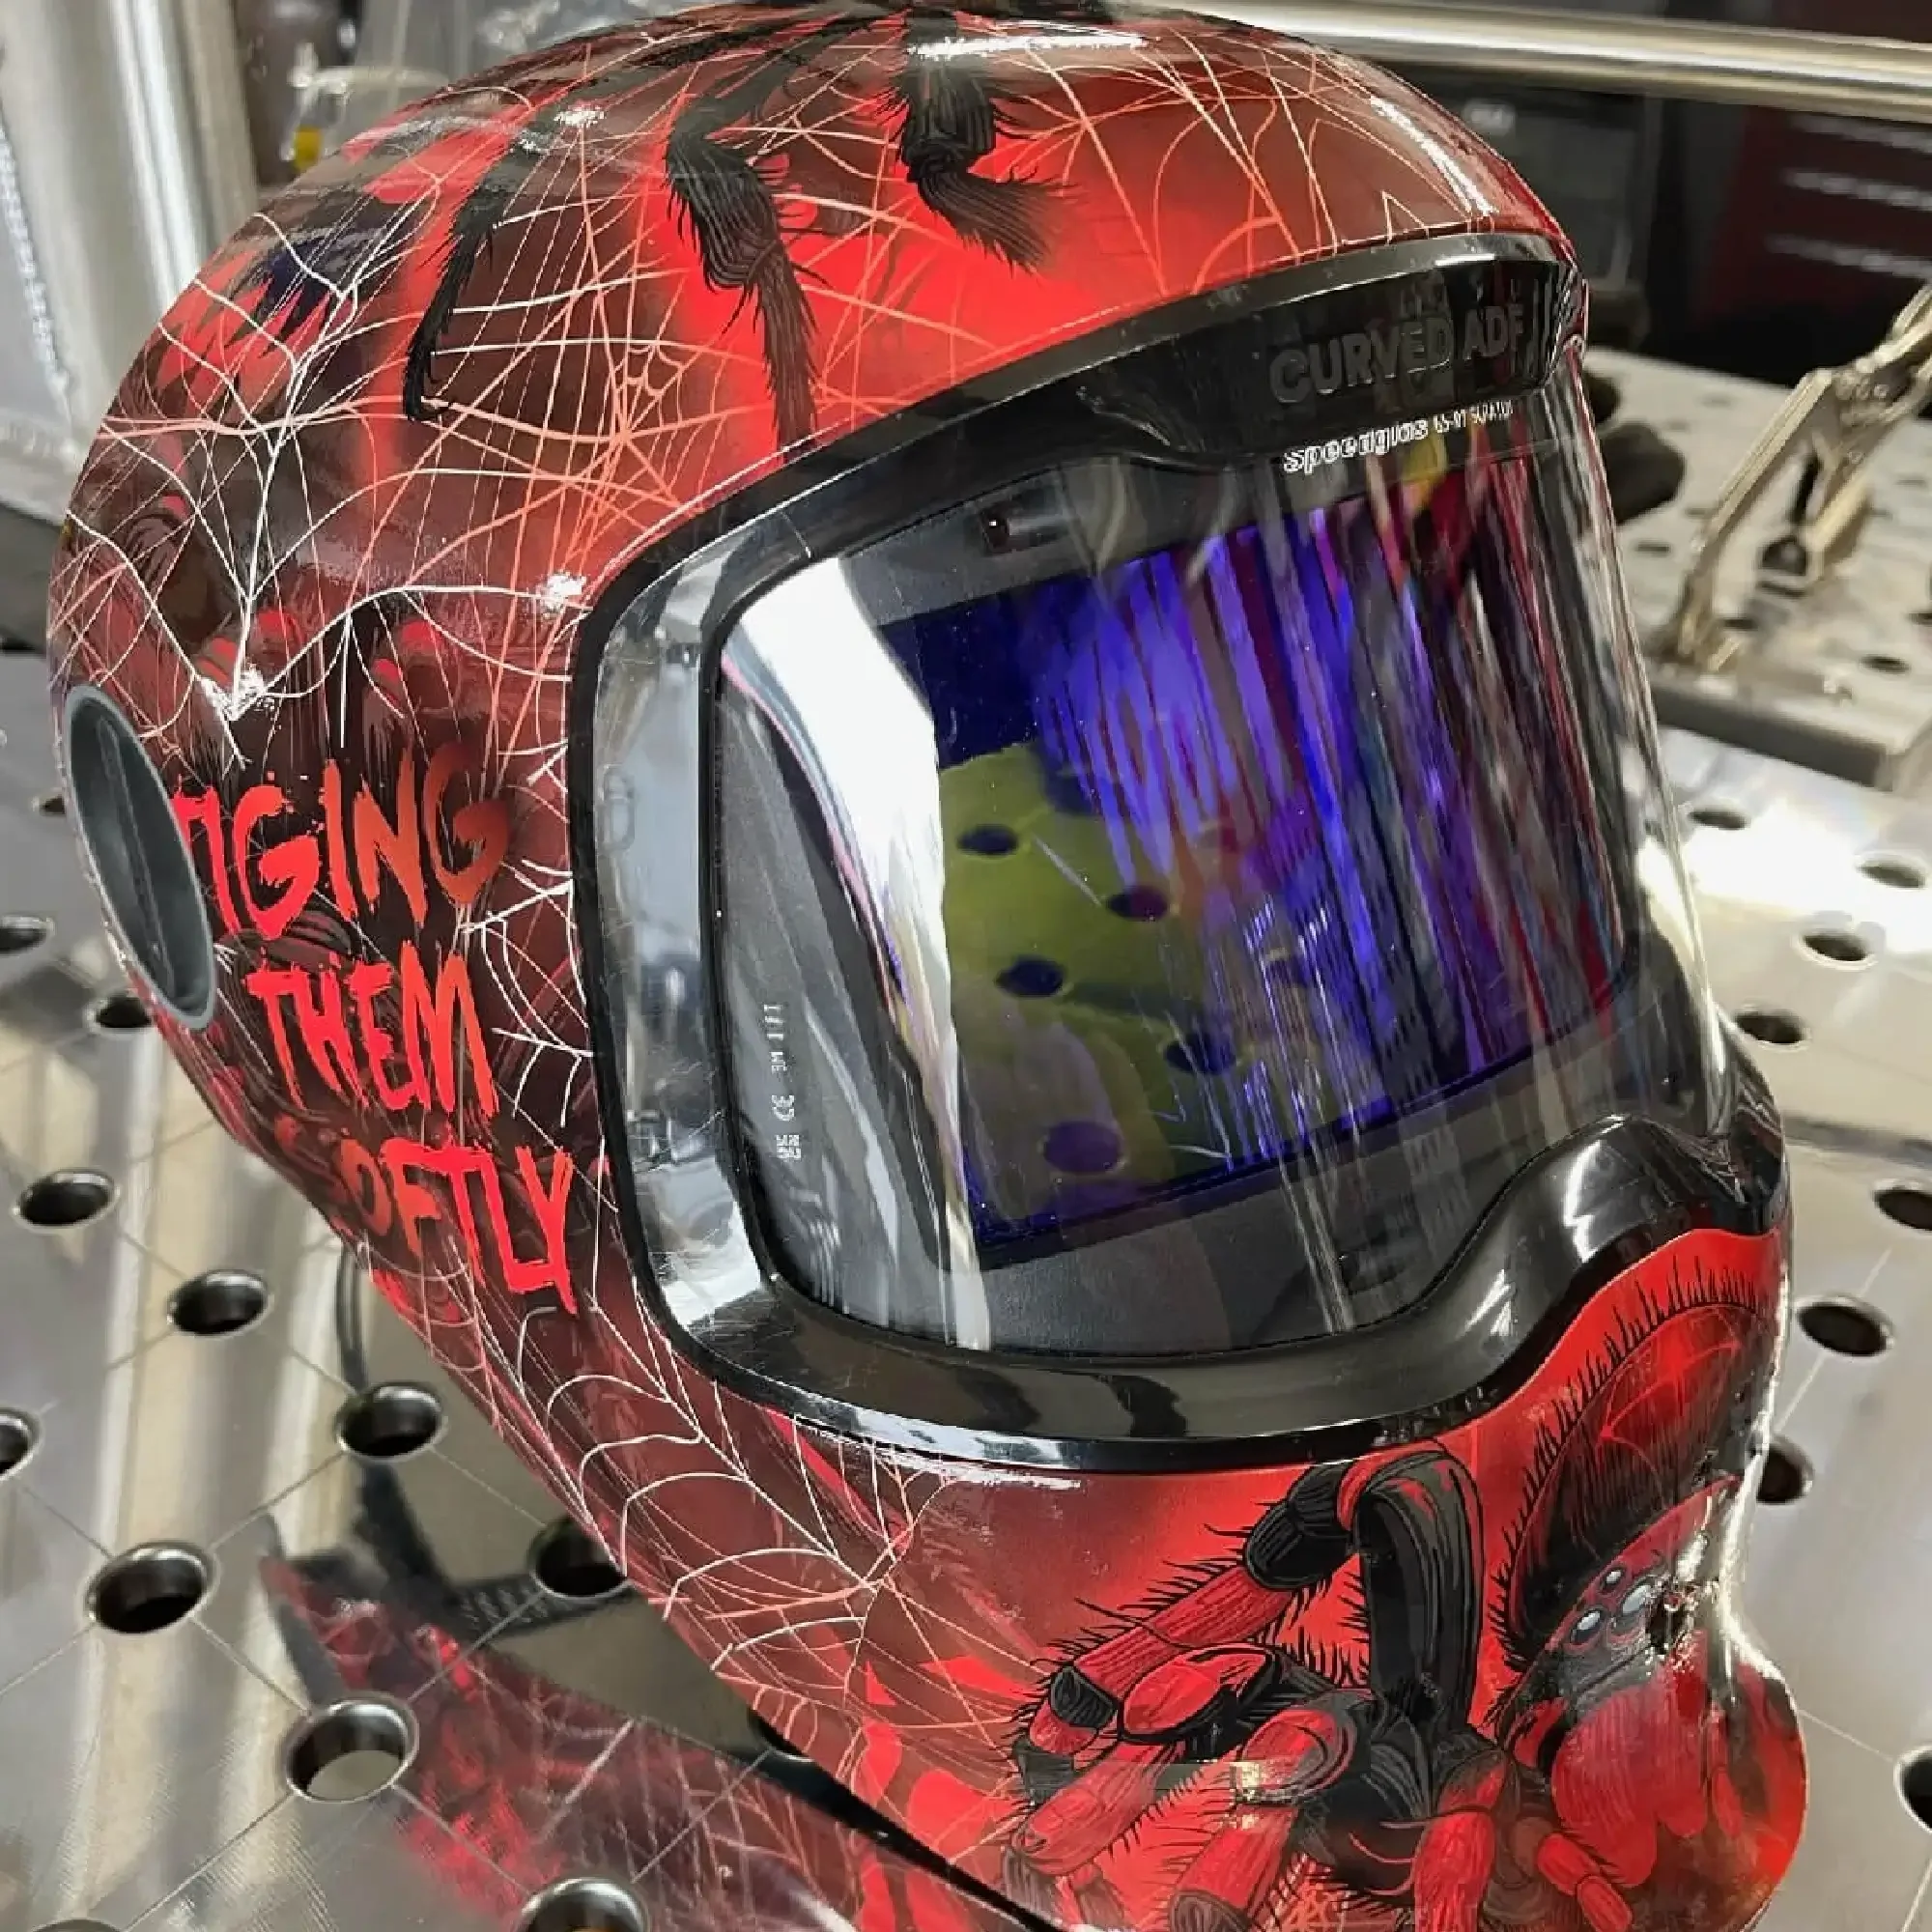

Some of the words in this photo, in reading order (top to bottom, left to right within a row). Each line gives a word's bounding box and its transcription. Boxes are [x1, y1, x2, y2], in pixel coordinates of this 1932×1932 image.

[1268, 317, 1454, 405] CURVED
[1463, 302, 1523, 360] ADF
[243, 939, 501, 1118] THEM
